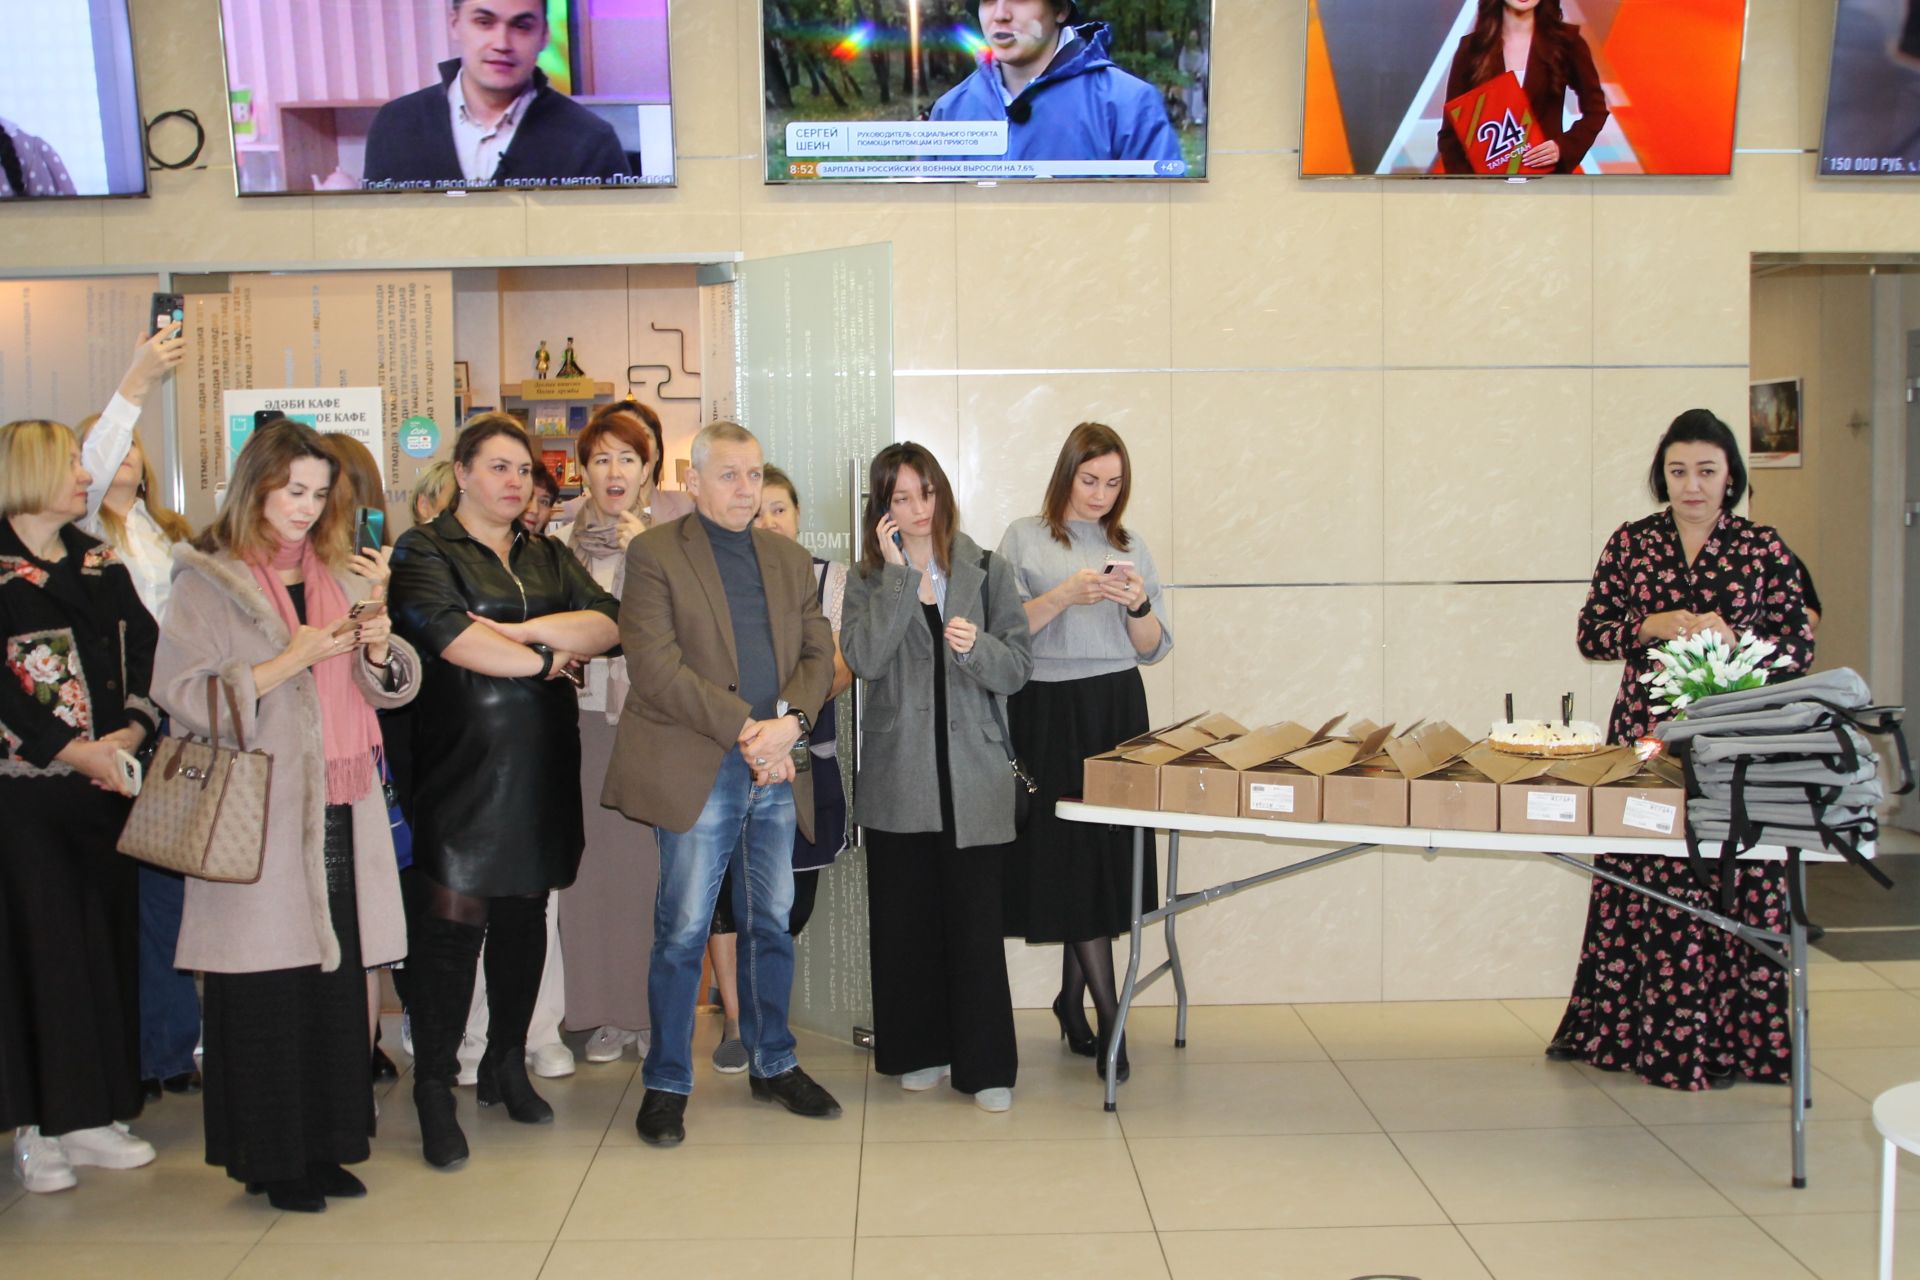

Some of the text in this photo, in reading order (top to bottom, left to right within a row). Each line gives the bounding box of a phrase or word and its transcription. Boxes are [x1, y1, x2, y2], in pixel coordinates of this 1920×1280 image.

[796, 126, 838, 138] СЕРГЕЙ
[1477, 107, 1525, 162] 24
[1487, 142, 1532, 170] ТАТАРСТАН
[789, 164, 814, 175] 8:52
[1830, 157, 1851, 171] 150
[1855, 157, 1877, 171] 000
[550, 177, 558, 186] с
[264, 399, 340, 410] ӘДӘБИ КАФЕ
[316, 412, 366, 422] ОЕ КАФЕ
